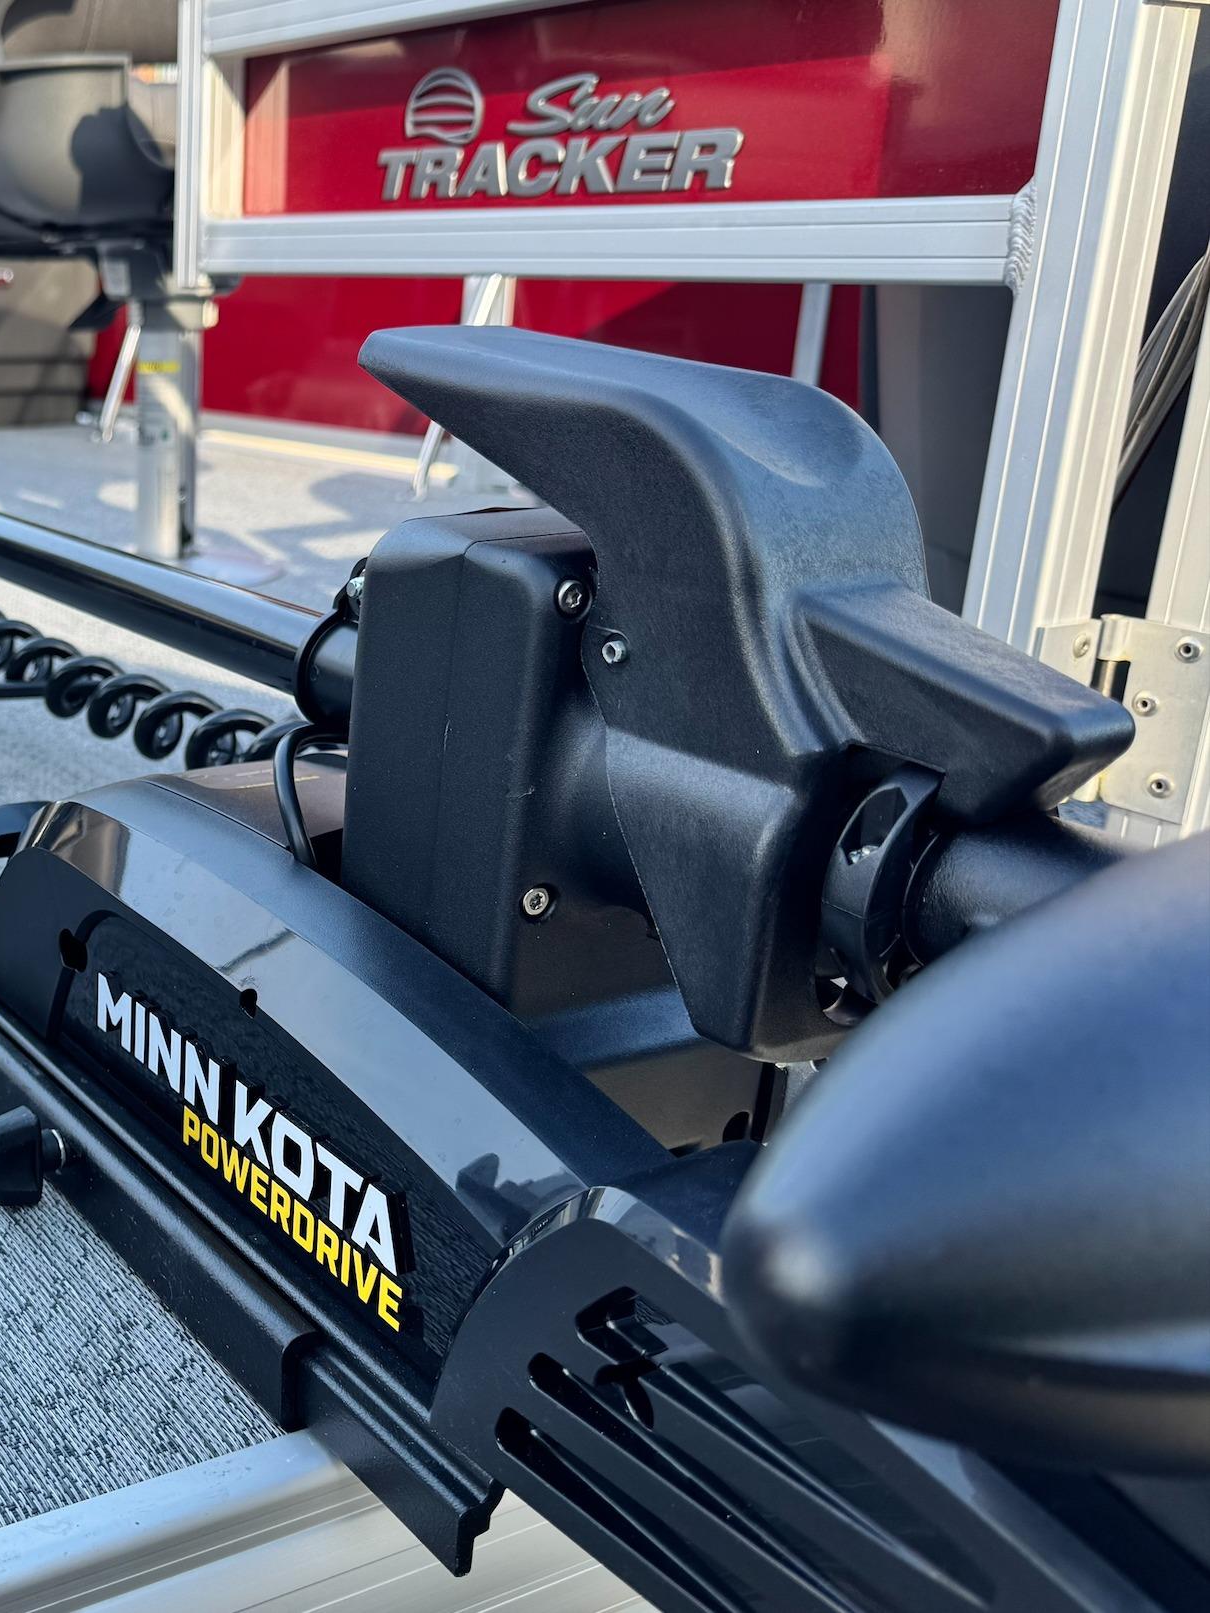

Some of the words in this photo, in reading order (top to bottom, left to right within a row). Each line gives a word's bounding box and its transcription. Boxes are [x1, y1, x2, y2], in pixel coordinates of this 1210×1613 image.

[378, 127, 744, 201] TRACKER
[506, 72, 674, 135] Sun
[97, 972, 221, 1126] MINN
[234, 1079, 398, 1277] KOTA
[182, 1105, 404, 1333] POWERDRIVE
